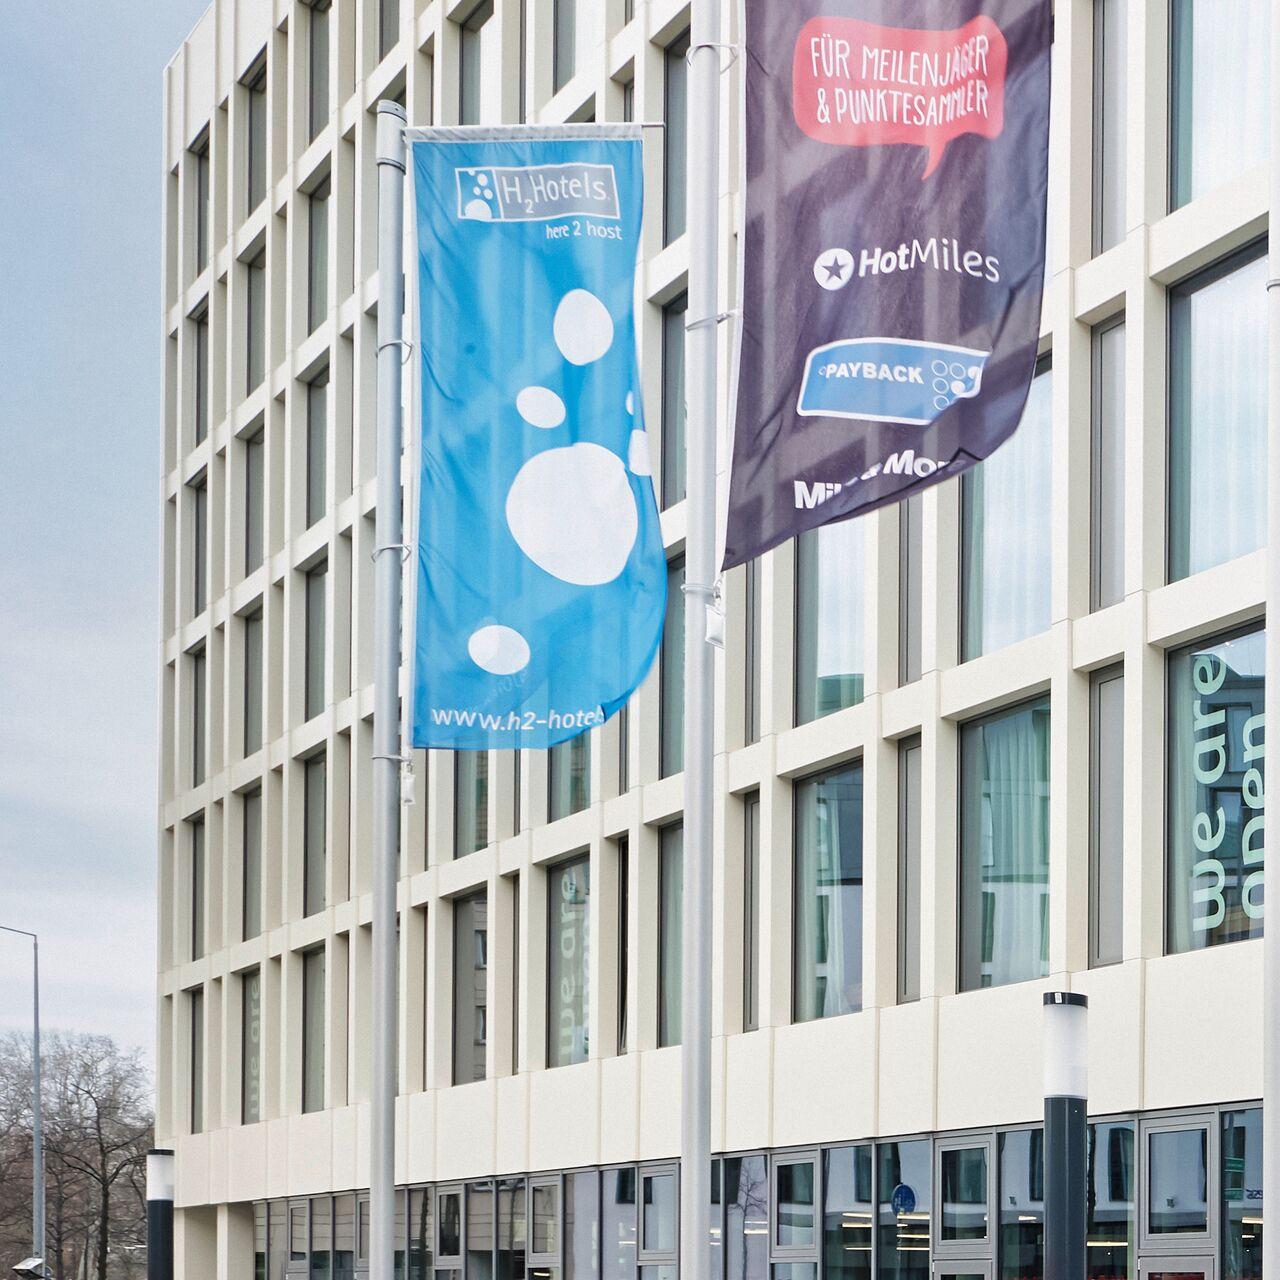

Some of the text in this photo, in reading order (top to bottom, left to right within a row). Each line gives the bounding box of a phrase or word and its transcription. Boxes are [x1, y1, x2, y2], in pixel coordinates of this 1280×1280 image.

[810, 33, 990, 88] FÜR MEILENJÄGER
[816, 79, 989, 126] & PUNKTESAMMLER
[546, 220, 623, 240] here 2 host
[858, 238, 1000, 283] HotMiles
[1192, 654, 1226, 932] we are
